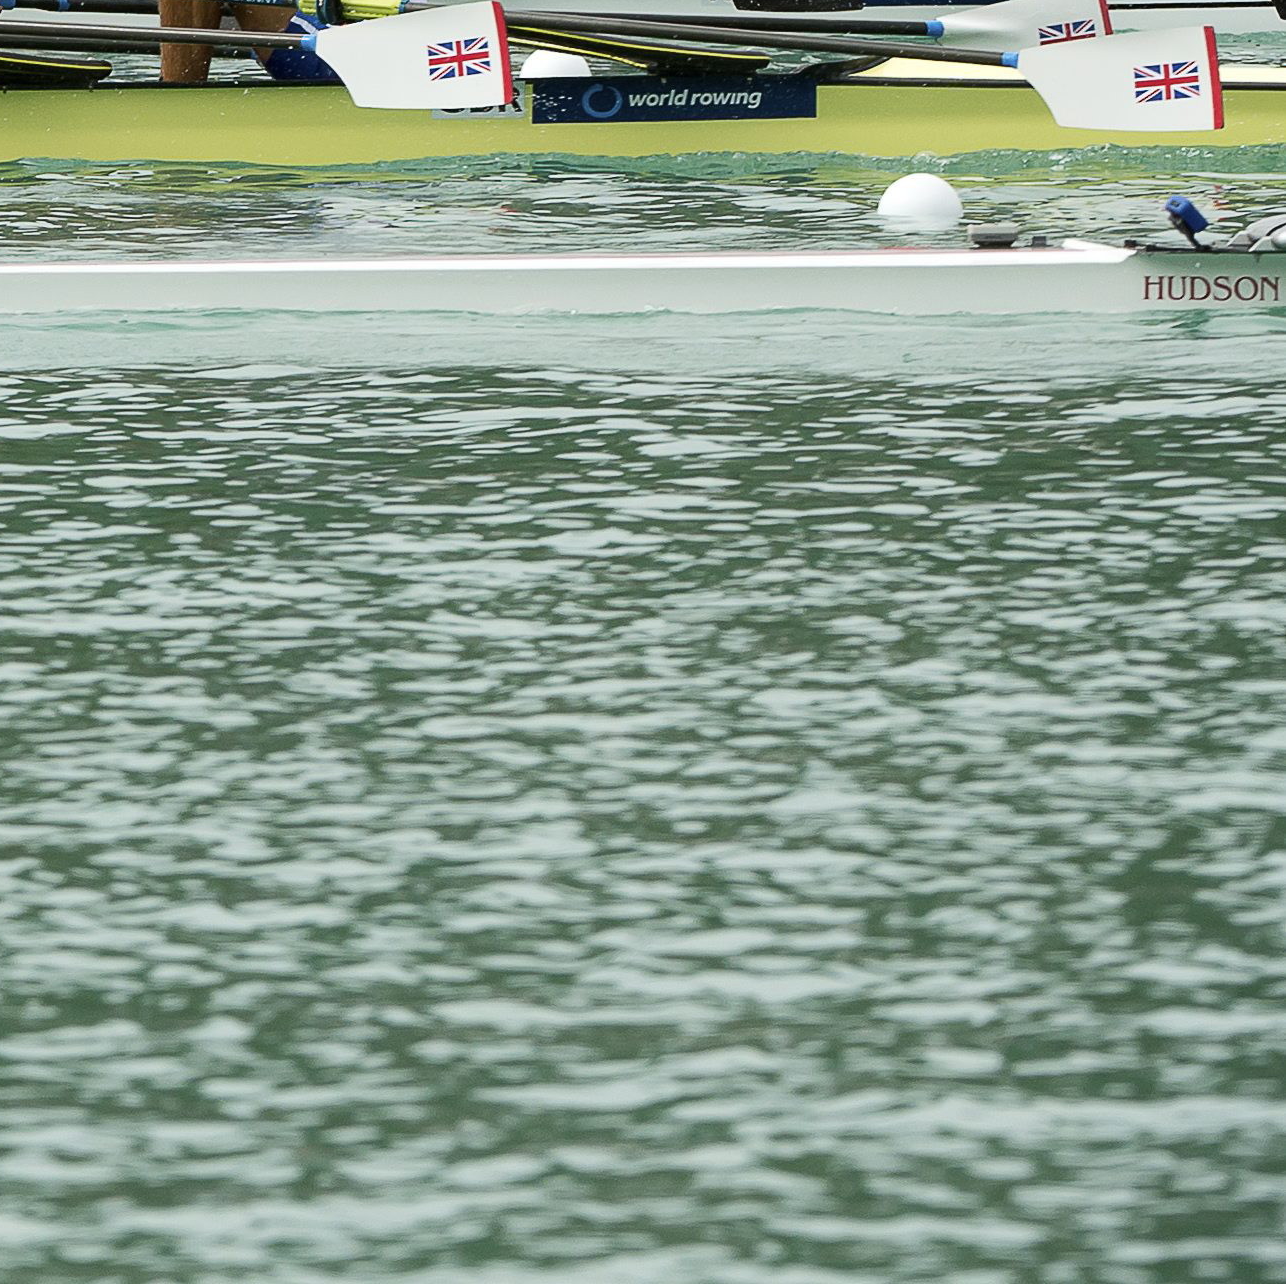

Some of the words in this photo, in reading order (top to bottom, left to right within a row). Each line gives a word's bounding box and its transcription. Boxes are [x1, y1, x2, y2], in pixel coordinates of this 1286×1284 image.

[628, 89, 686, 107] world
[690, 90, 763, 110] rowing
[1143, 275, 1281, 302] HUDSON
